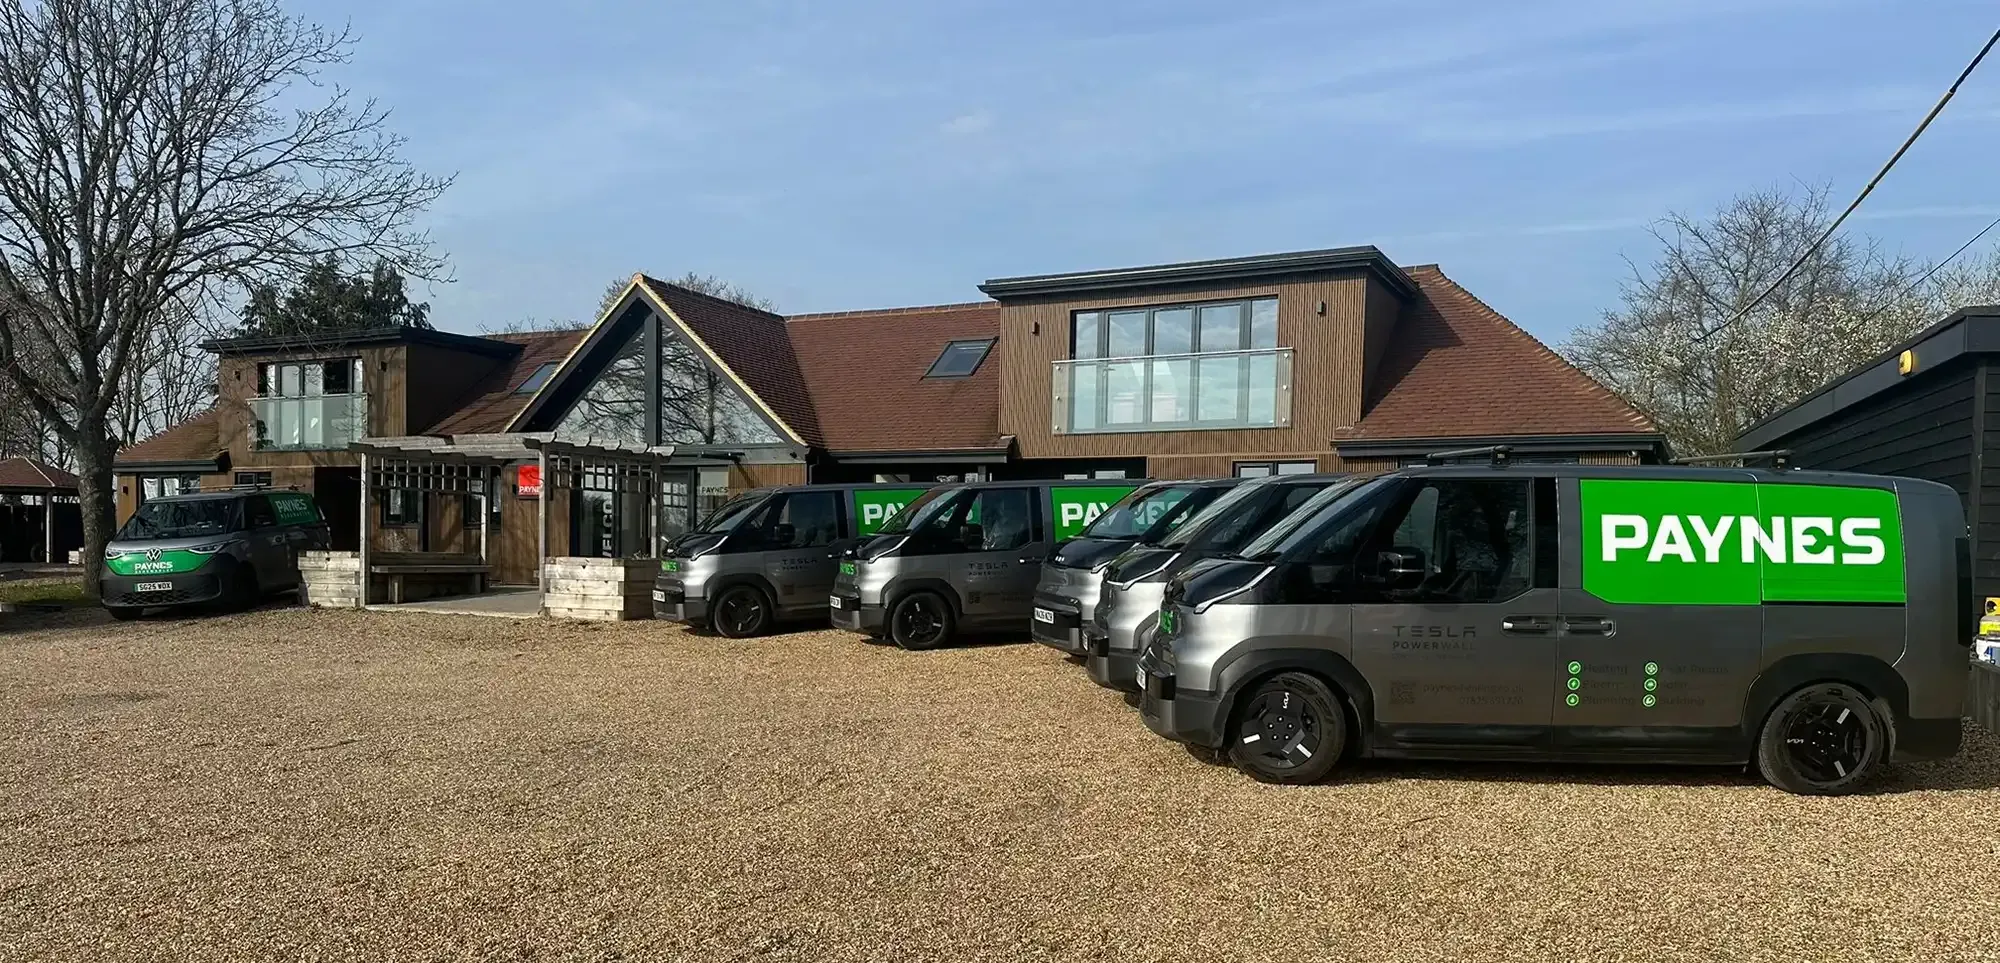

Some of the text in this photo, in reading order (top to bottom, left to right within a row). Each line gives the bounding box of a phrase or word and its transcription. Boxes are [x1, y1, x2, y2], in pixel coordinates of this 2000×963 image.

[274, 498, 308, 513] PAYNES
[862, 503, 905, 525] PA
[602, 500, 613, 558] ELCO
[1601, 513, 1886, 565] PAYNES
[134, 561, 173, 571] PAYNES
[968, 561, 1008, 570] TESLA
[1392, 625, 1477, 638] TESLA
[1392, 641, 1477, 650] POWERWALL
